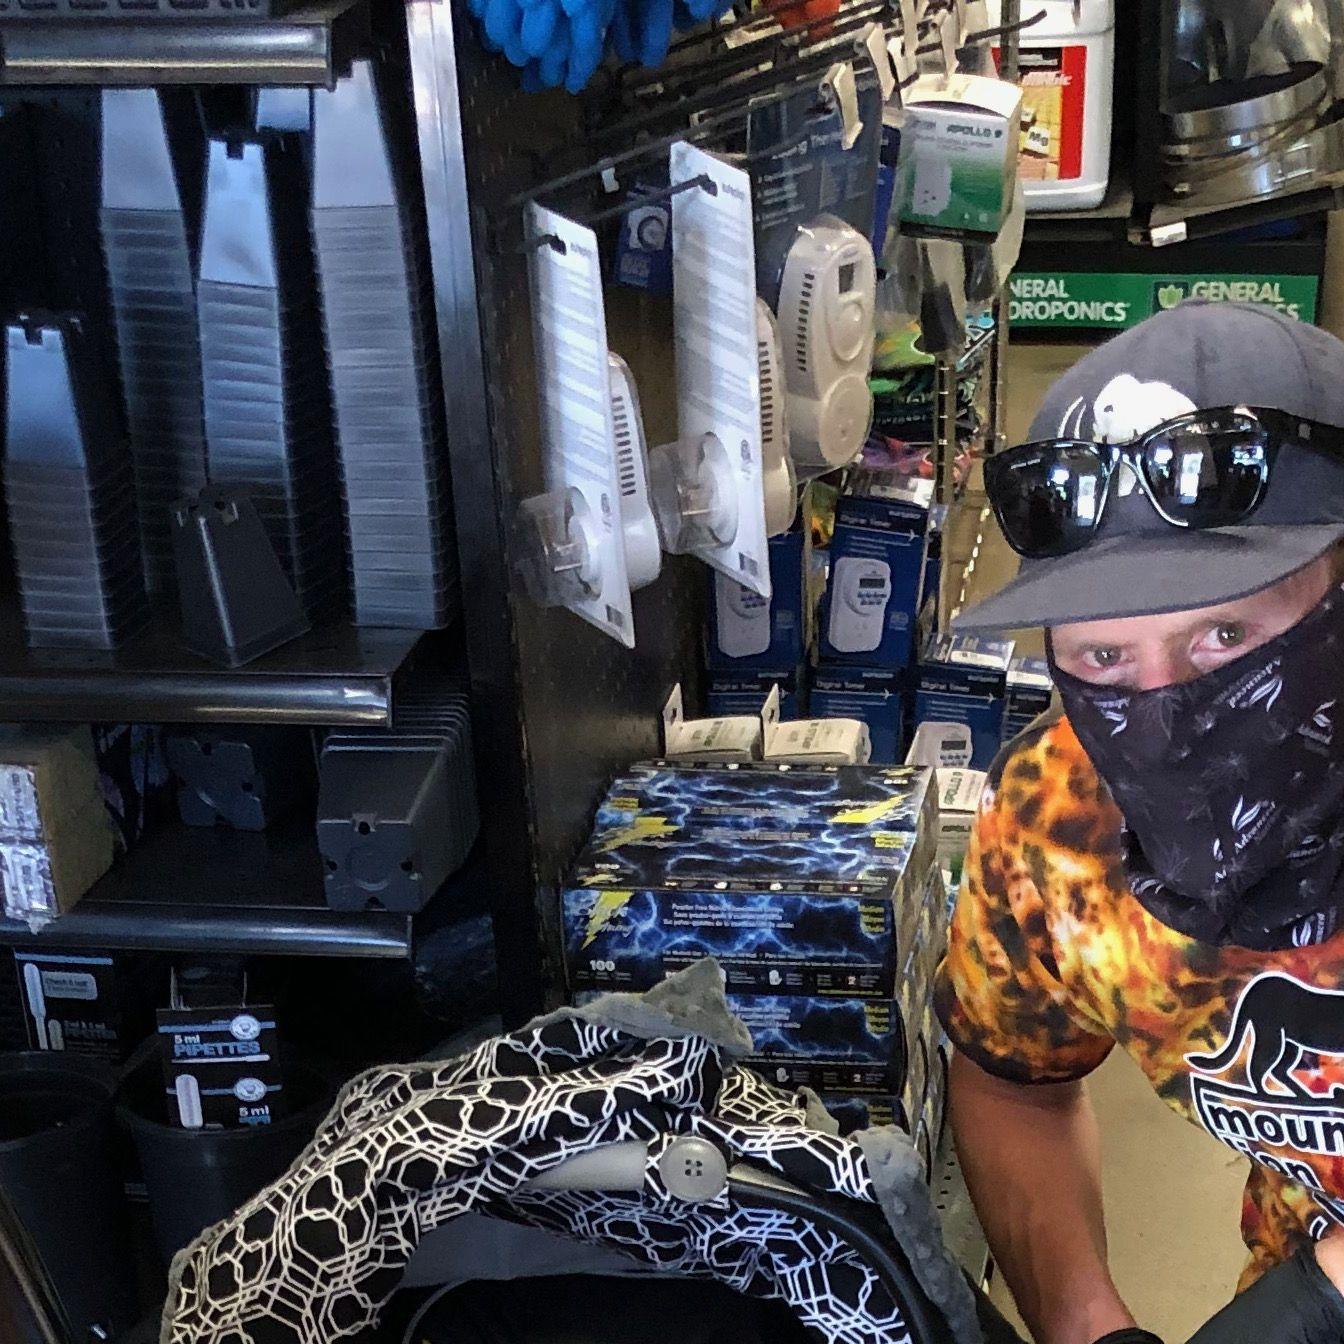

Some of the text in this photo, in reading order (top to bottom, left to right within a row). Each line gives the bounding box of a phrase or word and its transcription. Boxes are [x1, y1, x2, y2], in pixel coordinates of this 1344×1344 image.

[1009, 279, 1069, 298] NERAL
[1192, 281, 1285, 303] GENERAL
[1009, 301, 1128, 322] DROPONICS
[174, 1042, 261, 1057] PIPETTES
